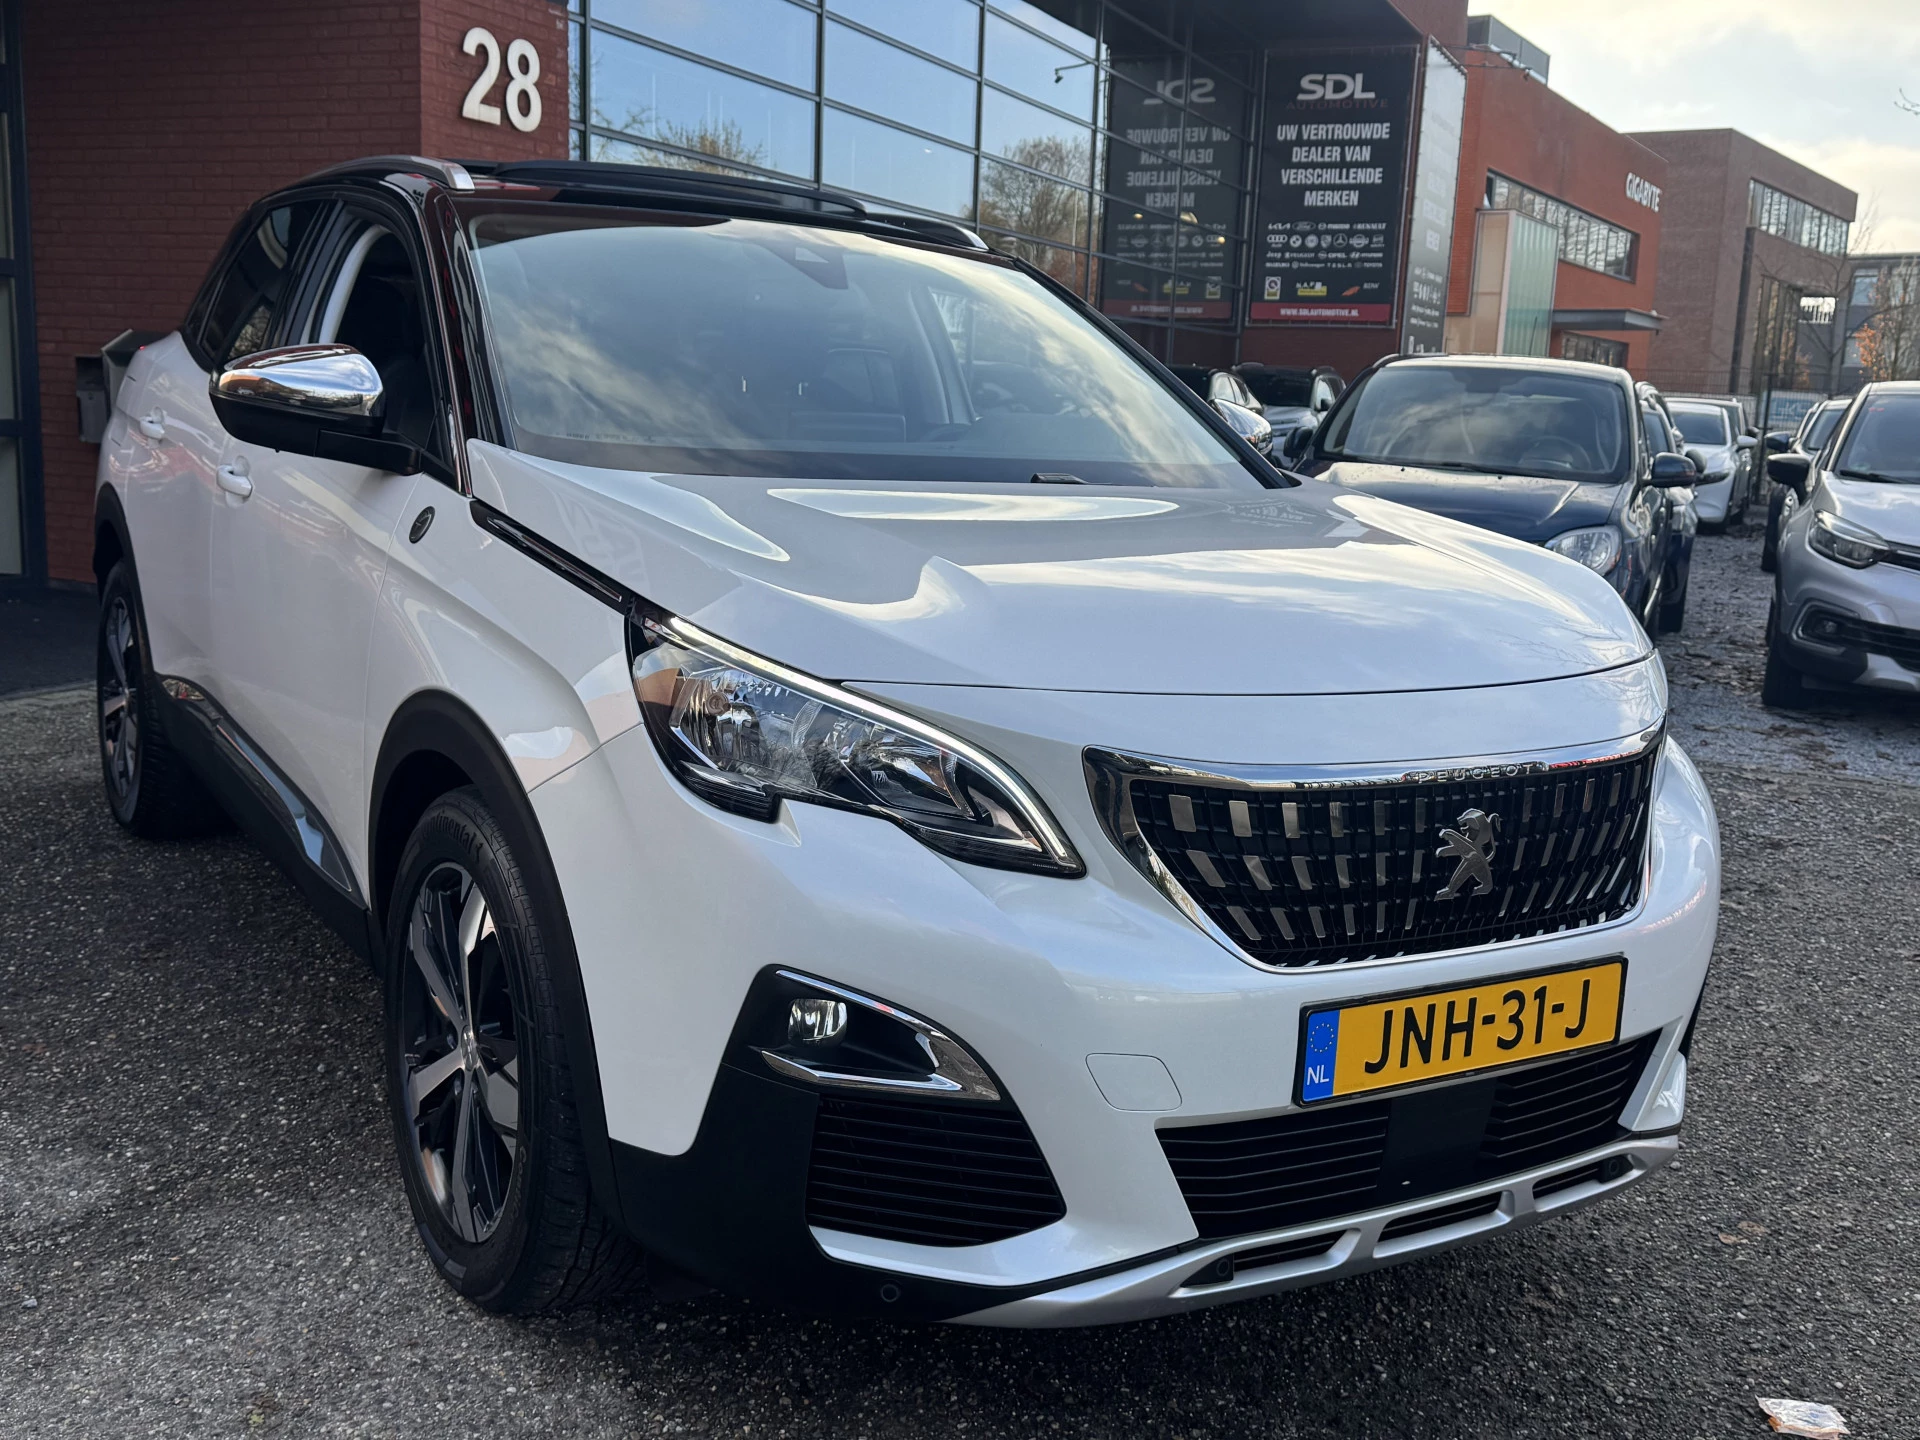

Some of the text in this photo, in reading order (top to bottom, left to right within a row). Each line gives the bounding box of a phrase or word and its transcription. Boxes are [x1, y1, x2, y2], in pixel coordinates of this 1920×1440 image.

[462, 27, 542, 132] 28
[1297, 73, 1375, 100] SDL
[1286, 99, 1388, 110] AUTOMOTIVE
[1277, 122, 1390, 141] UW VERTROUWDE
[1291, 145, 1371, 162] DEALER VAN
[1281, 167, 1383, 185] VERSCHILLENDE
[1304, 190, 1359, 206] MERKEN
[1626, 171, 1660, 213] GIGABYTE
[1418, 763, 1533, 784] PEUGEOT
[1364, 978, 1591, 1075] JNH-31-J
[1307, 1064, 1330, 1086] NL
